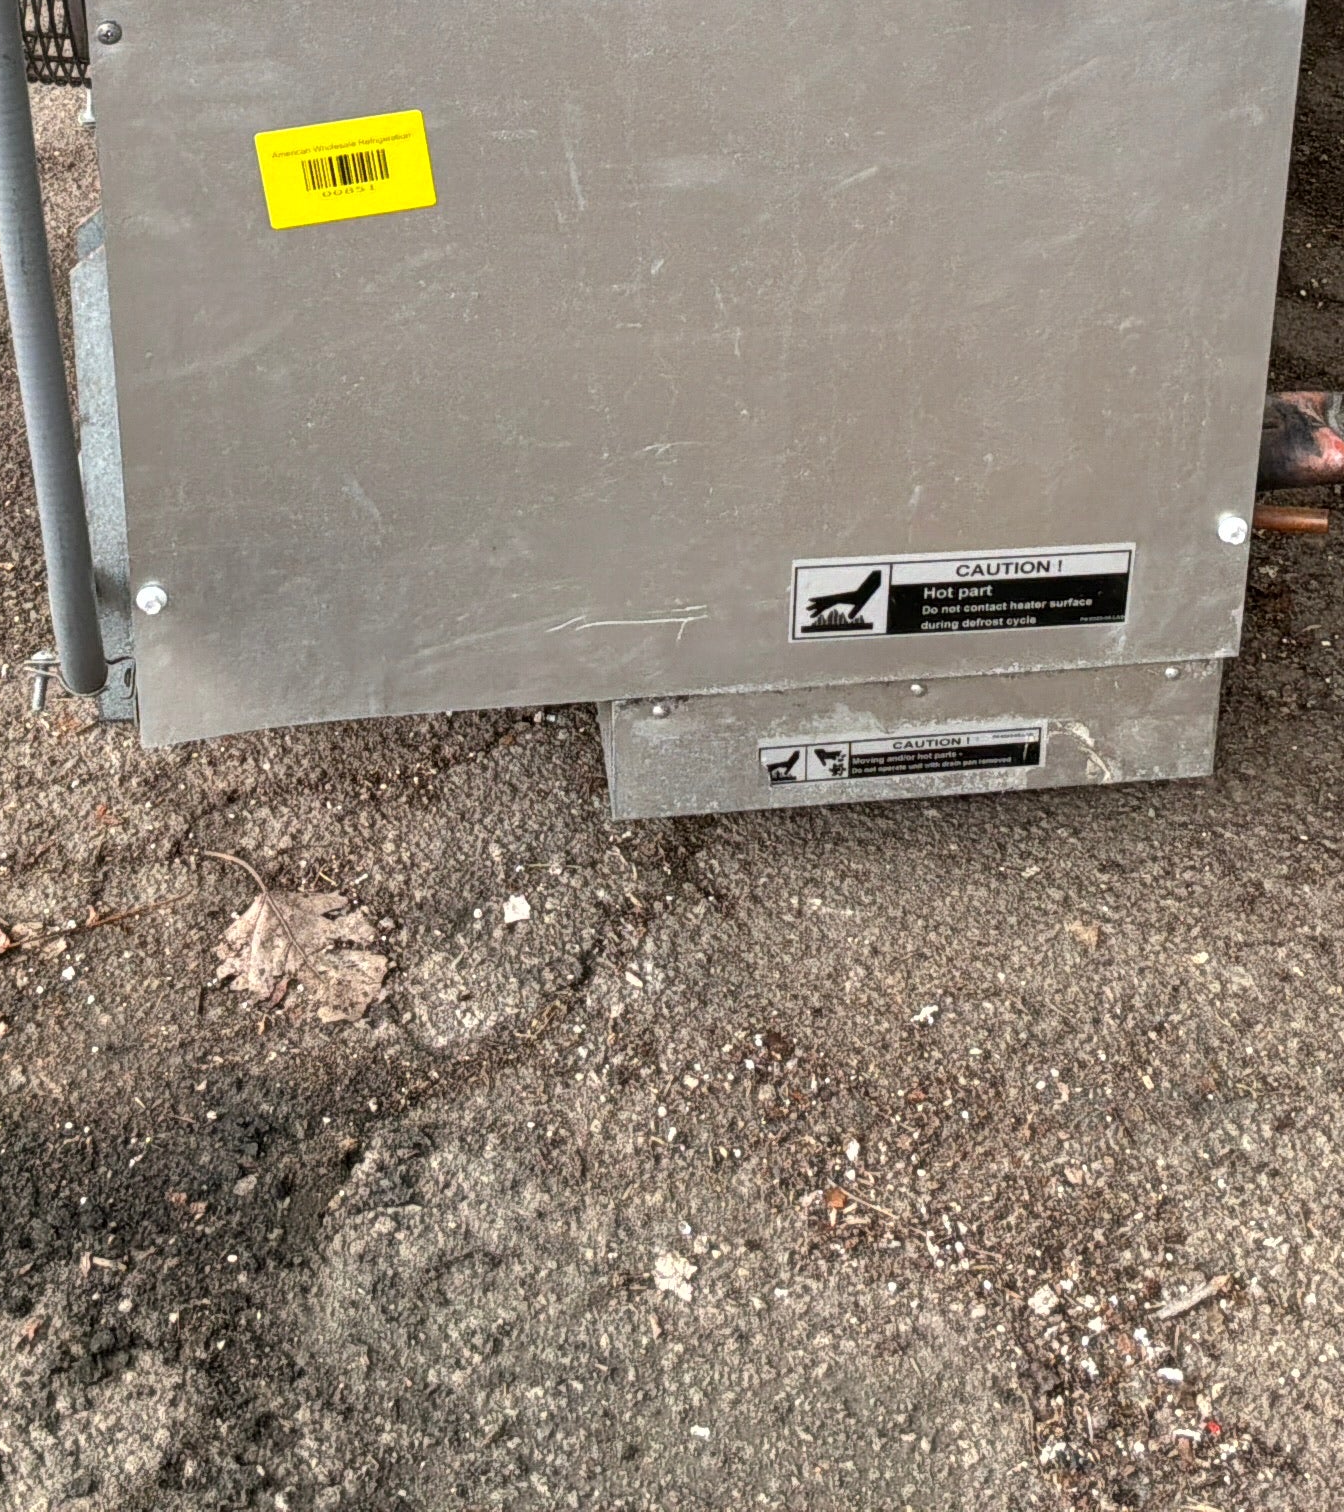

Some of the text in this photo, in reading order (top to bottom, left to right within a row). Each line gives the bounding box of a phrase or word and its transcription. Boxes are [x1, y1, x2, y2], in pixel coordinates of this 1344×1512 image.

[272, 133, 412, 158] American Wholesale Refrigeration
[956, 559, 1063, 577] CAUTION !
[923, 585, 993, 600] Hot part
[922, 598, 1093, 615] Do not contact heater surface
[920, 615, 1037, 631] during defrost cycle
[892, 736, 971, 750] CAUTION !
[852, 756, 885, 765] Moving
[886, 753, 915, 763] and/or
[917, 752, 932, 760] hot
[934, 751, 956, 760] parts
[908, 762, 923, 770] unit
[924, 761, 940, 769] with
[963, 759, 977, 767] pan
